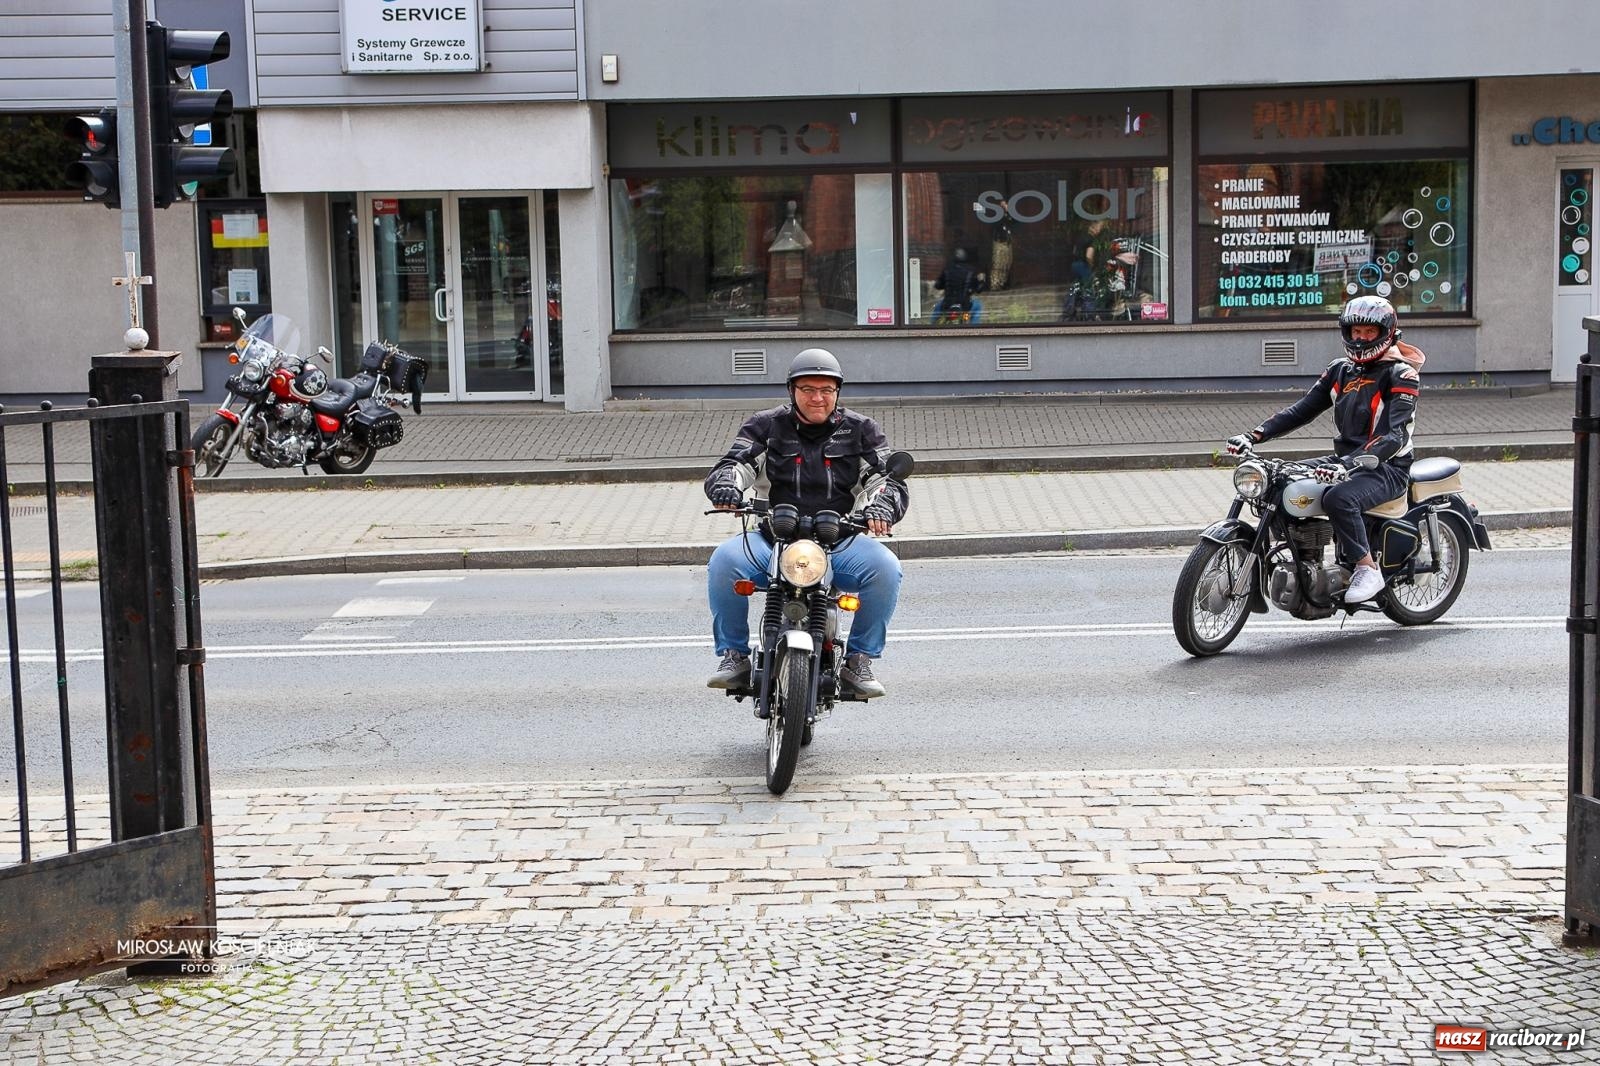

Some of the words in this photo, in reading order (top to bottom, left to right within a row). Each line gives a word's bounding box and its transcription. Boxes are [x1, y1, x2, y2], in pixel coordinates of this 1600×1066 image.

[382, 7, 467, 22] SERVICE
[357, 38, 406, 51] Systemy
[409, 37, 466, 48] Grzewcze
[351, 52, 355, 62] i
[358, 52, 413, 62] Sanitarne
[423, 52, 442, 63] Sp.
[444, 53, 451, 61] z
[453, 53, 473, 61] o.o.
[656, 116, 841, 158] klima
[908, 106, 1162, 152] ogrzewanie
[1221, 178, 1264, 193] PRANIE
[975, 179, 1146, 224] solar
[1221, 195, 1301, 211] MAGLOWANIE
[1221, 214, 1264, 229] PRANIE
[1266, 210, 1331, 227] DYWANÓW
[1221, 231, 1296, 247] CZYSZCZENIE
[1298, 229, 1366, 246] CHEMICZNE
[404, 242, 425, 256] SGS
[1221, 250, 1292, 265] GARDEROBY
[1219, 276, 1236, 290] tel
[1237, 275, 1262, 289] 032
[1263, 274, 1285, 289] 415
[1286, 274, 1303, 288] 30
[1305, 273, 1320, 287] 51
[1219, 293, 1249, 307] kom.
[1251, 293, 1275, 306] 604
[1277, 292, 1298, 306] 517
[1299, 291, 1323, 305] 306
